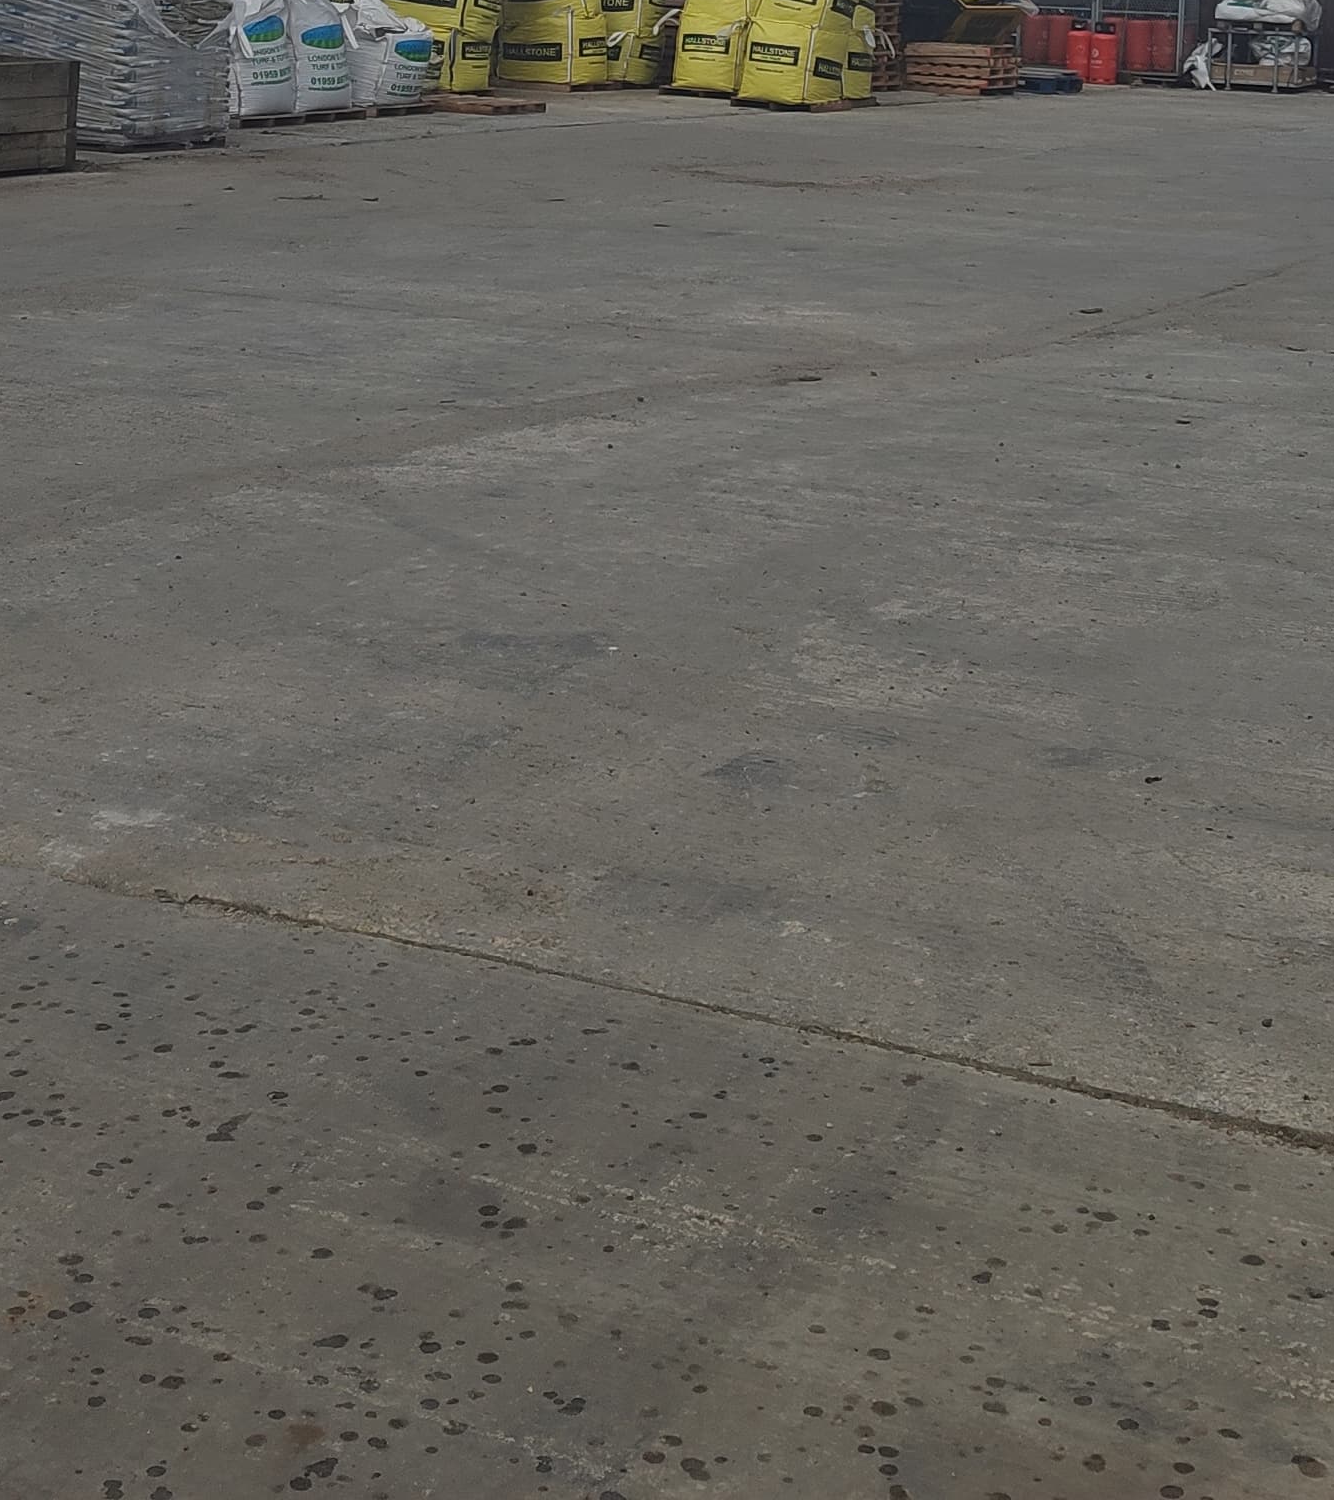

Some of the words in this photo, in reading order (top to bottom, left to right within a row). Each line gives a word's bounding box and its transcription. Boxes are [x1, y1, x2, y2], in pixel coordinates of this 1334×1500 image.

[507, 45, 557, 58] HALLSTONE
[753, 45, 796, 57] HALLSTONE
[253, 69, 279, 80] 01959
[311, 77, 336, 86] 01959
